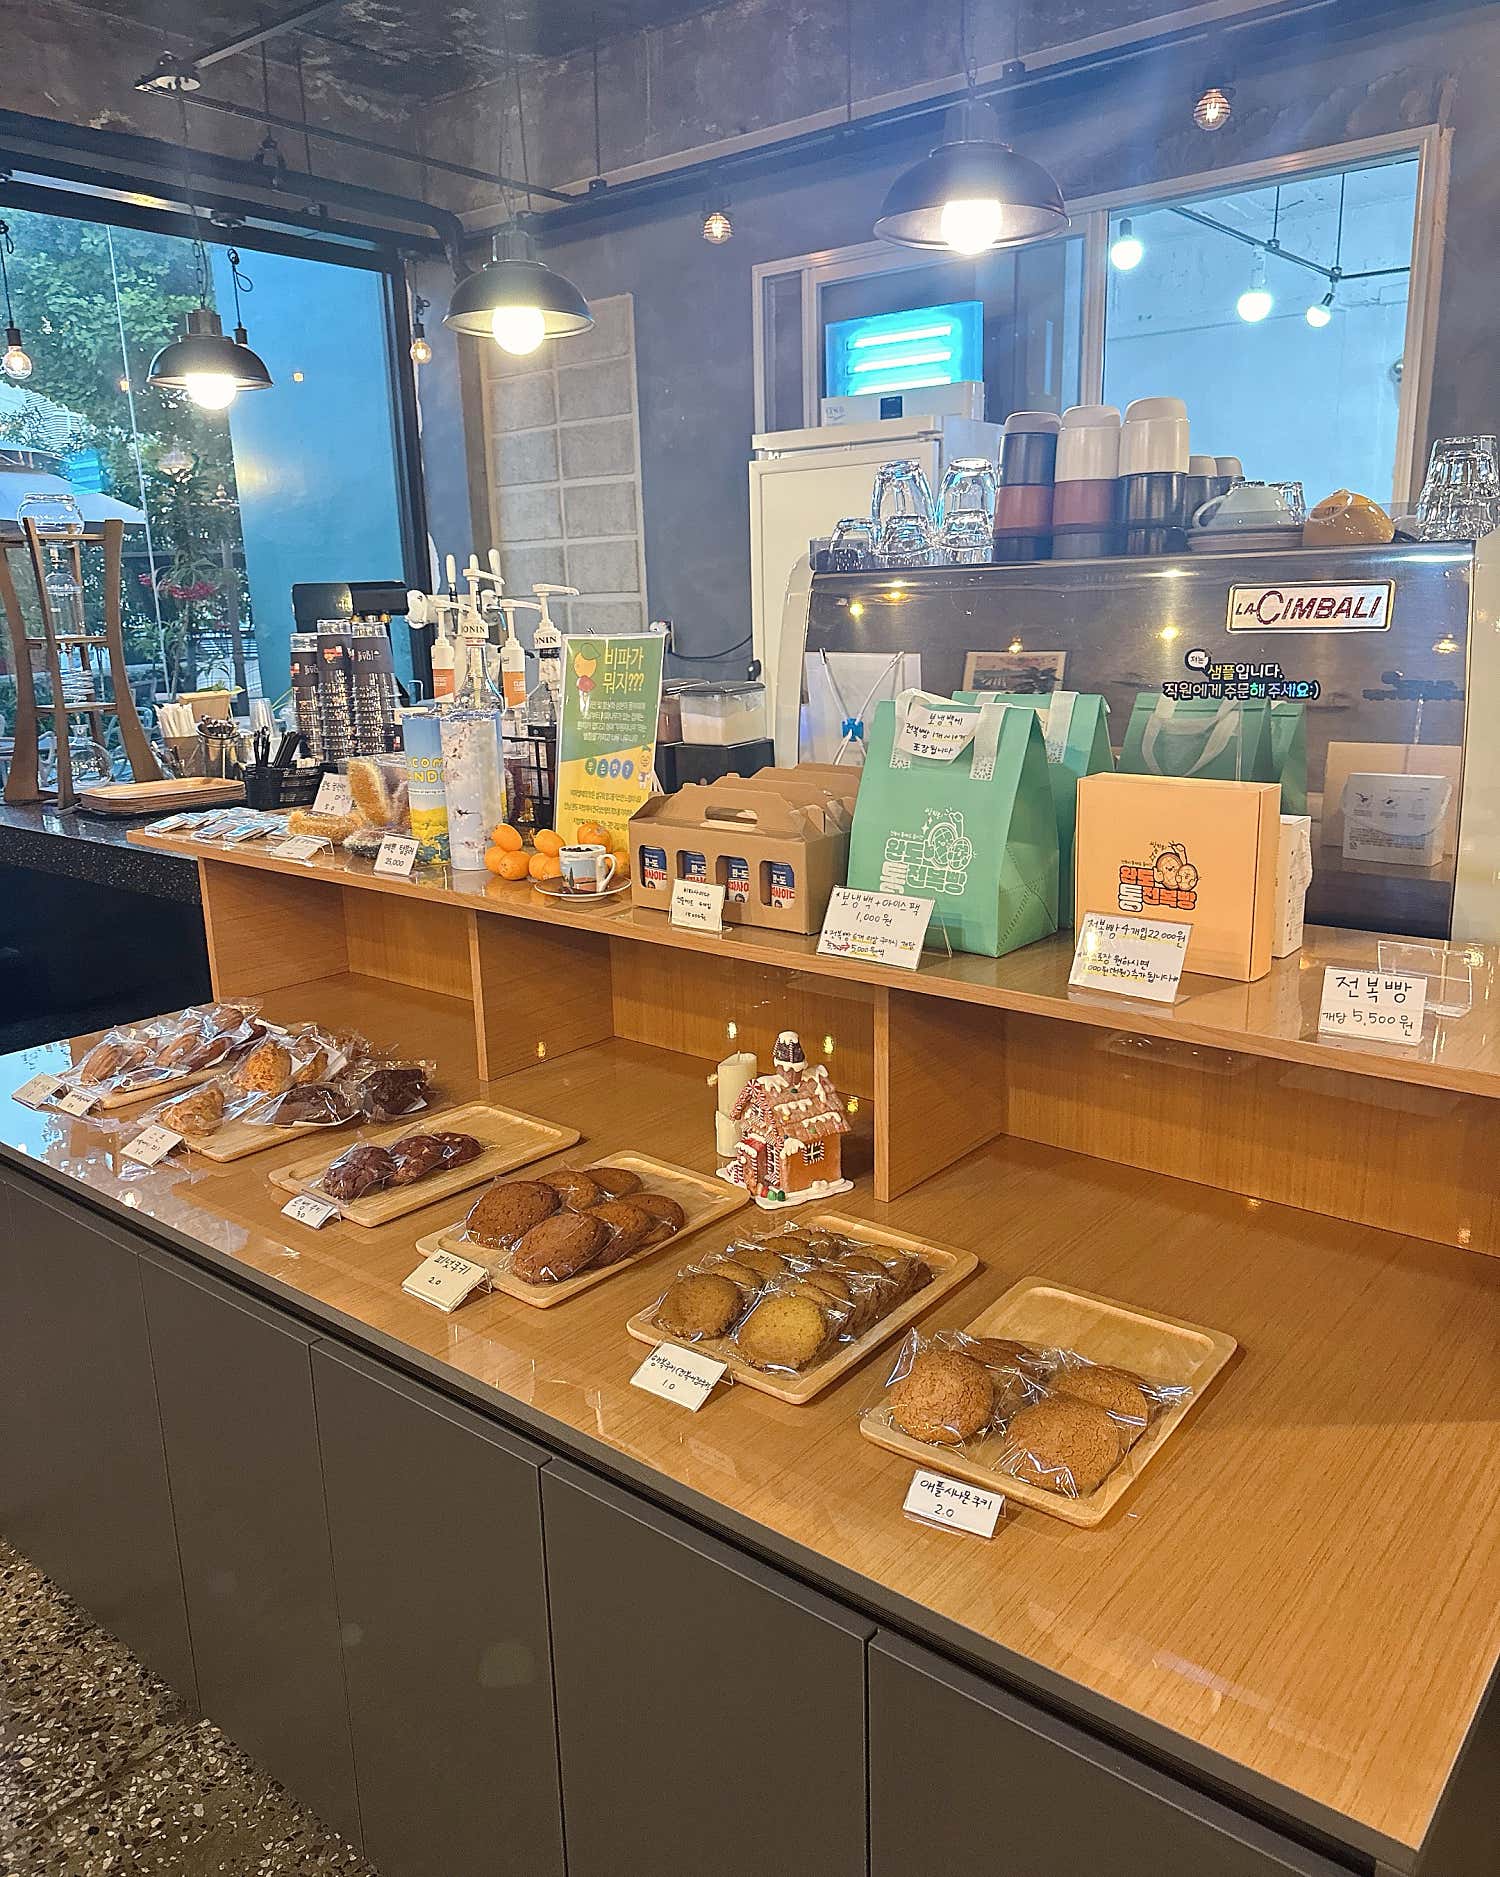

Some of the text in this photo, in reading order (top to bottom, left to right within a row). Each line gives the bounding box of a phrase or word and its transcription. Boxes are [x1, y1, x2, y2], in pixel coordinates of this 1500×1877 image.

[1235, 590, 1381, 625] LA CIMBALI
[604, 646, 644, 670] 비파가
[1207, 663, 1284, 680] 샘플입니다.
[602, 671, 645, 694] 뭐지???
[1164, 682, 1222, 699] 직원에게
[1224, 683, 1265, 698] 주문해
[928, 713, 964, 726] 보냉백에
[905, 723, 930, 739] 전복빵
[1113, 954, 1150, 970] 원하시면
[1335, 976, 1412, 1003] 전복빵
[1322, 1012, 1347, 1025] 개당
[934, 1503, 954, 1518] 2.0
